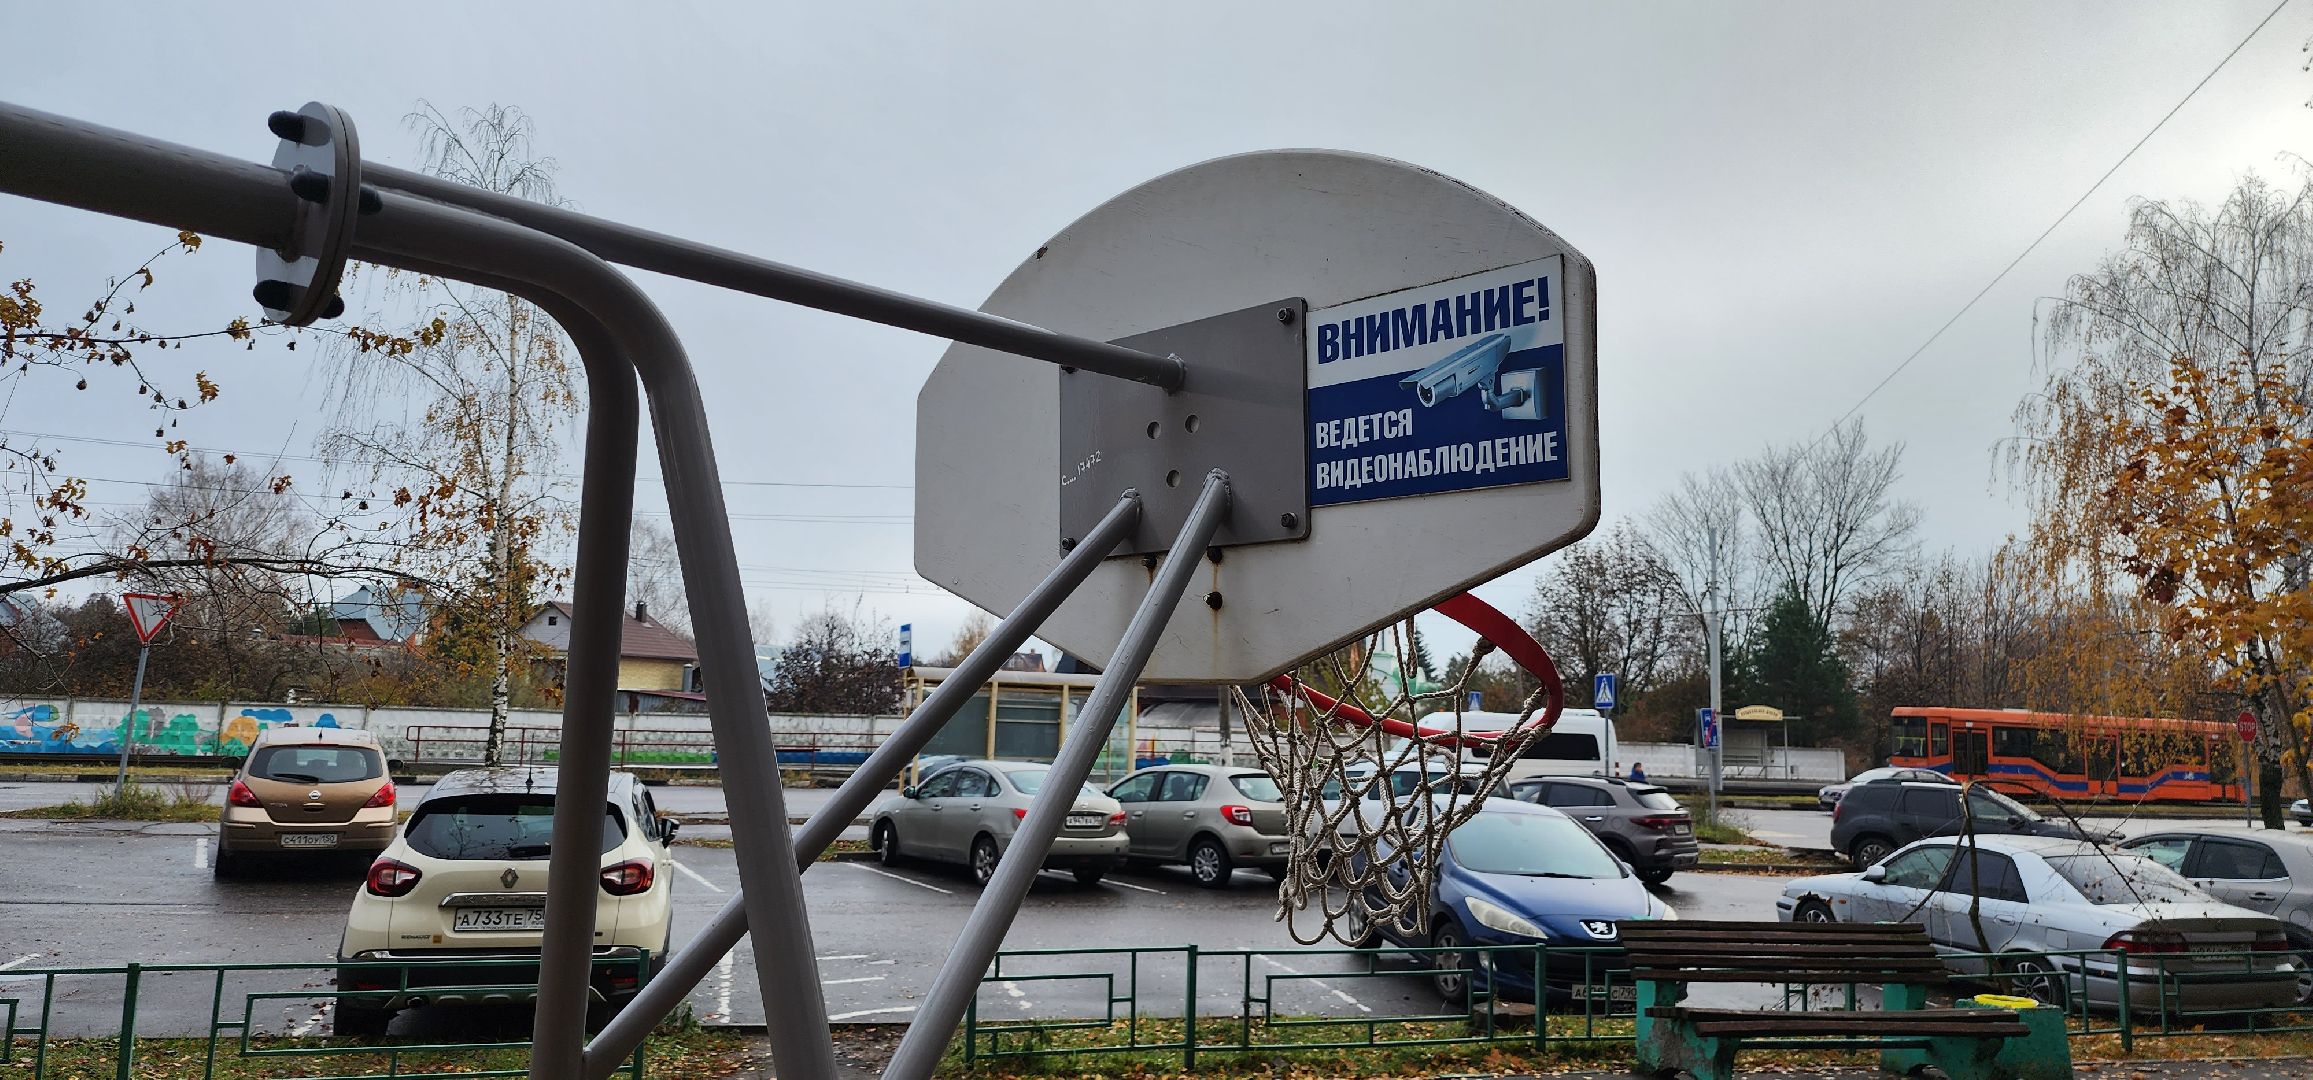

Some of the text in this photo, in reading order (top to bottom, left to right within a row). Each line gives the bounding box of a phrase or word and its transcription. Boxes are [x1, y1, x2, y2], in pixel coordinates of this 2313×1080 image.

[1317, 275, 1550, 365] ВНИМАНИЕ!
[1315, 408, 1413, 450] ВЕДЕТСЯ
[1316, 431, 1558, 490] ВИДЕОНАБЛЮДЕНИЕ
[2240, 721, 2256, 732] STOP
[459, 910, 524, 926] А733ТЕ
